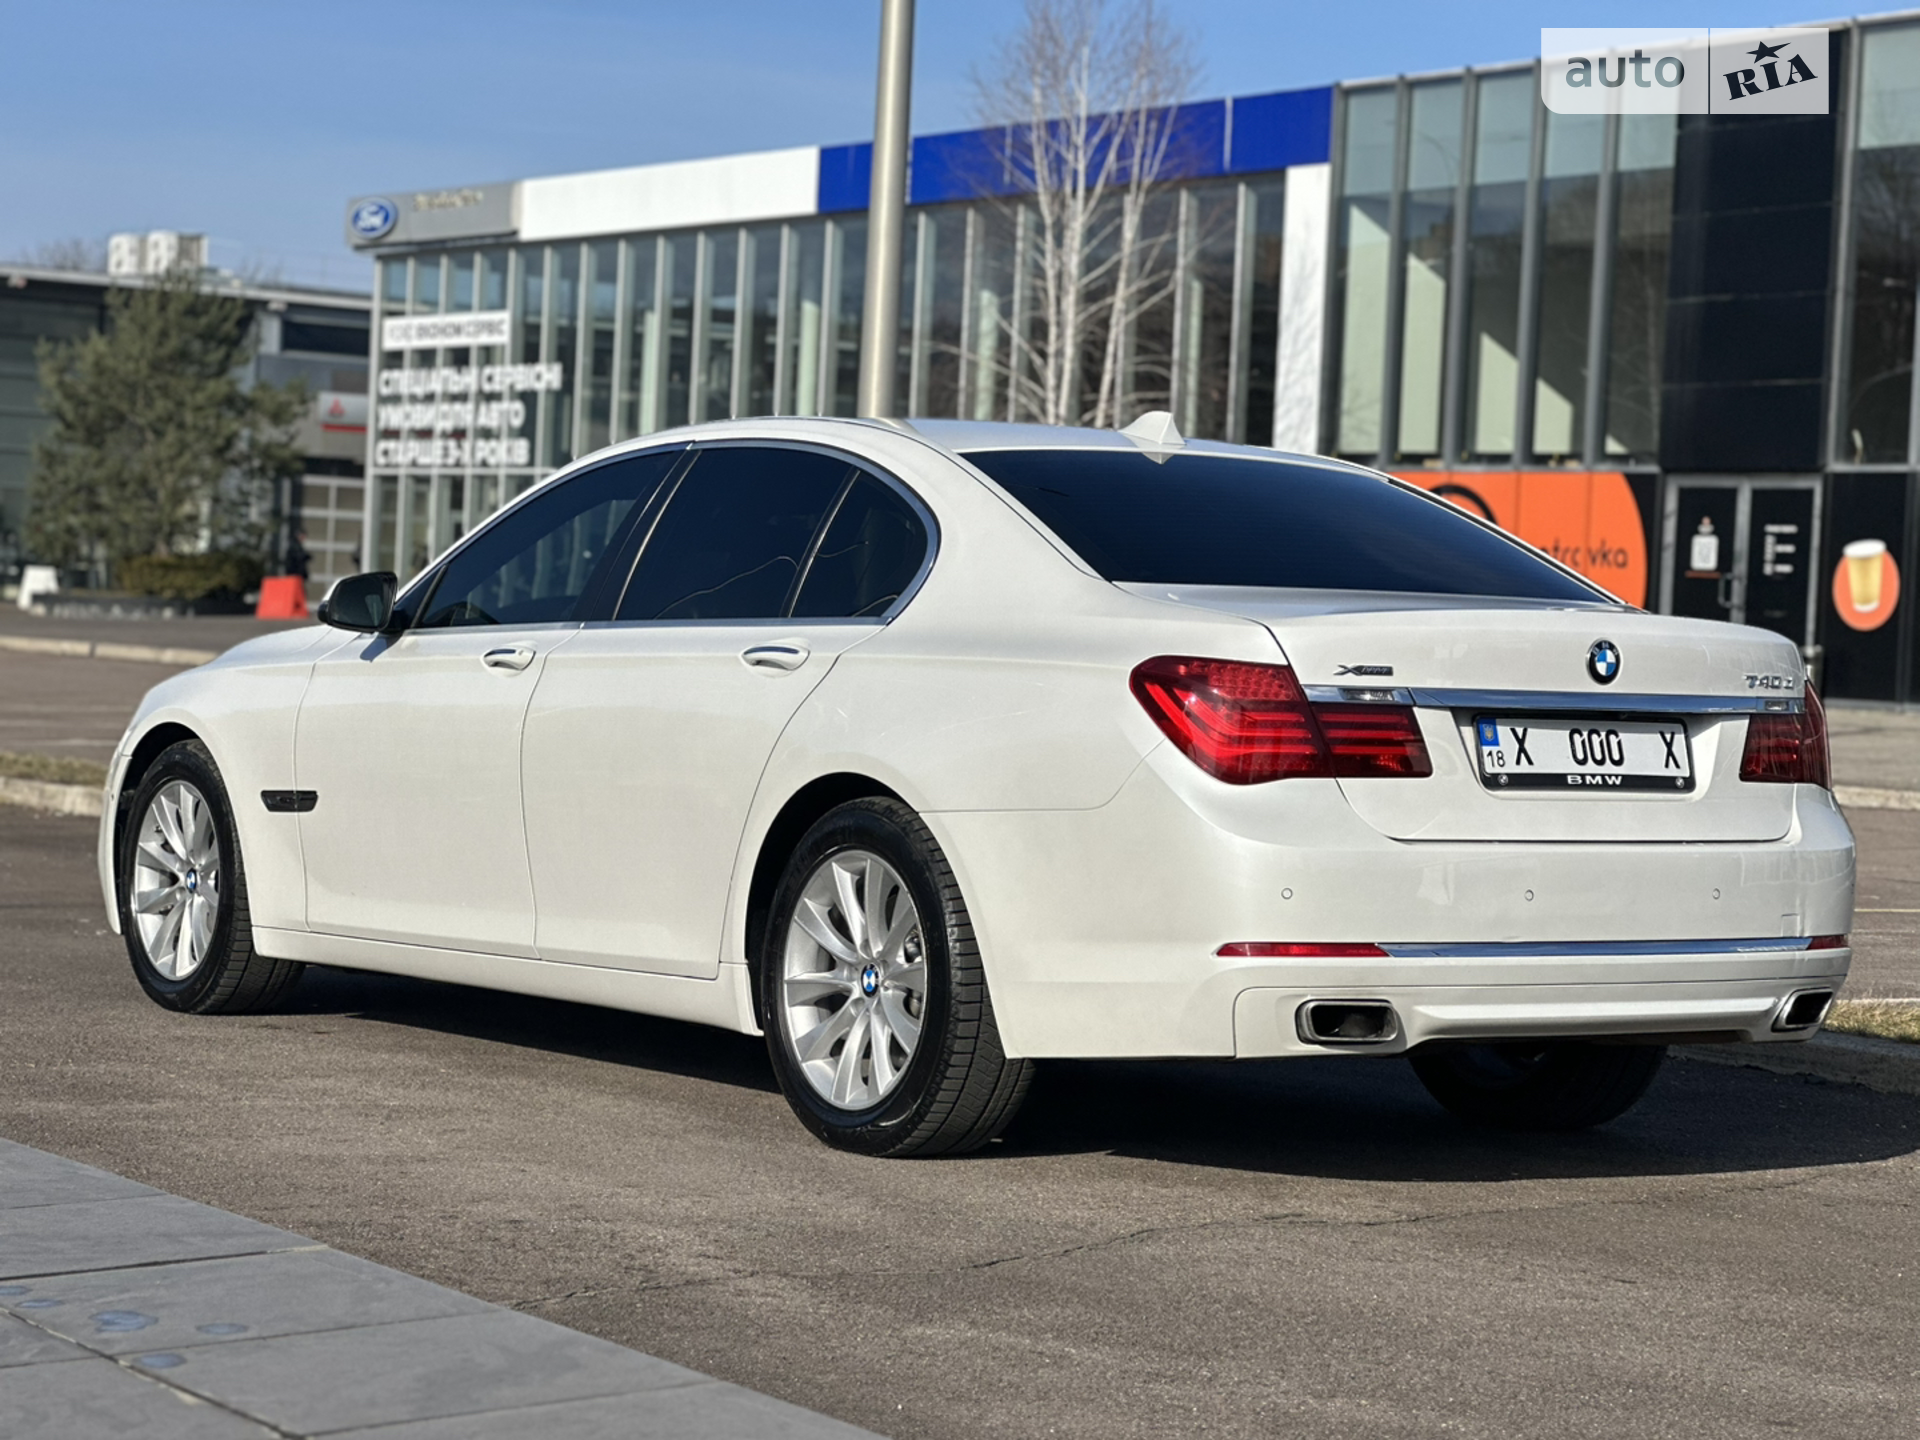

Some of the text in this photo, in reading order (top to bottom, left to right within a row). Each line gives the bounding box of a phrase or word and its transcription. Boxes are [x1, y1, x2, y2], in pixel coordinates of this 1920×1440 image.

[476, 400, 526, 428] АВТО
[1486, 749, 1506, 768] 18
[1510, 727, 1534, 766] X
[1658, 730, 1681, 769] X
[1567, 774, 1623, 785] BMW
